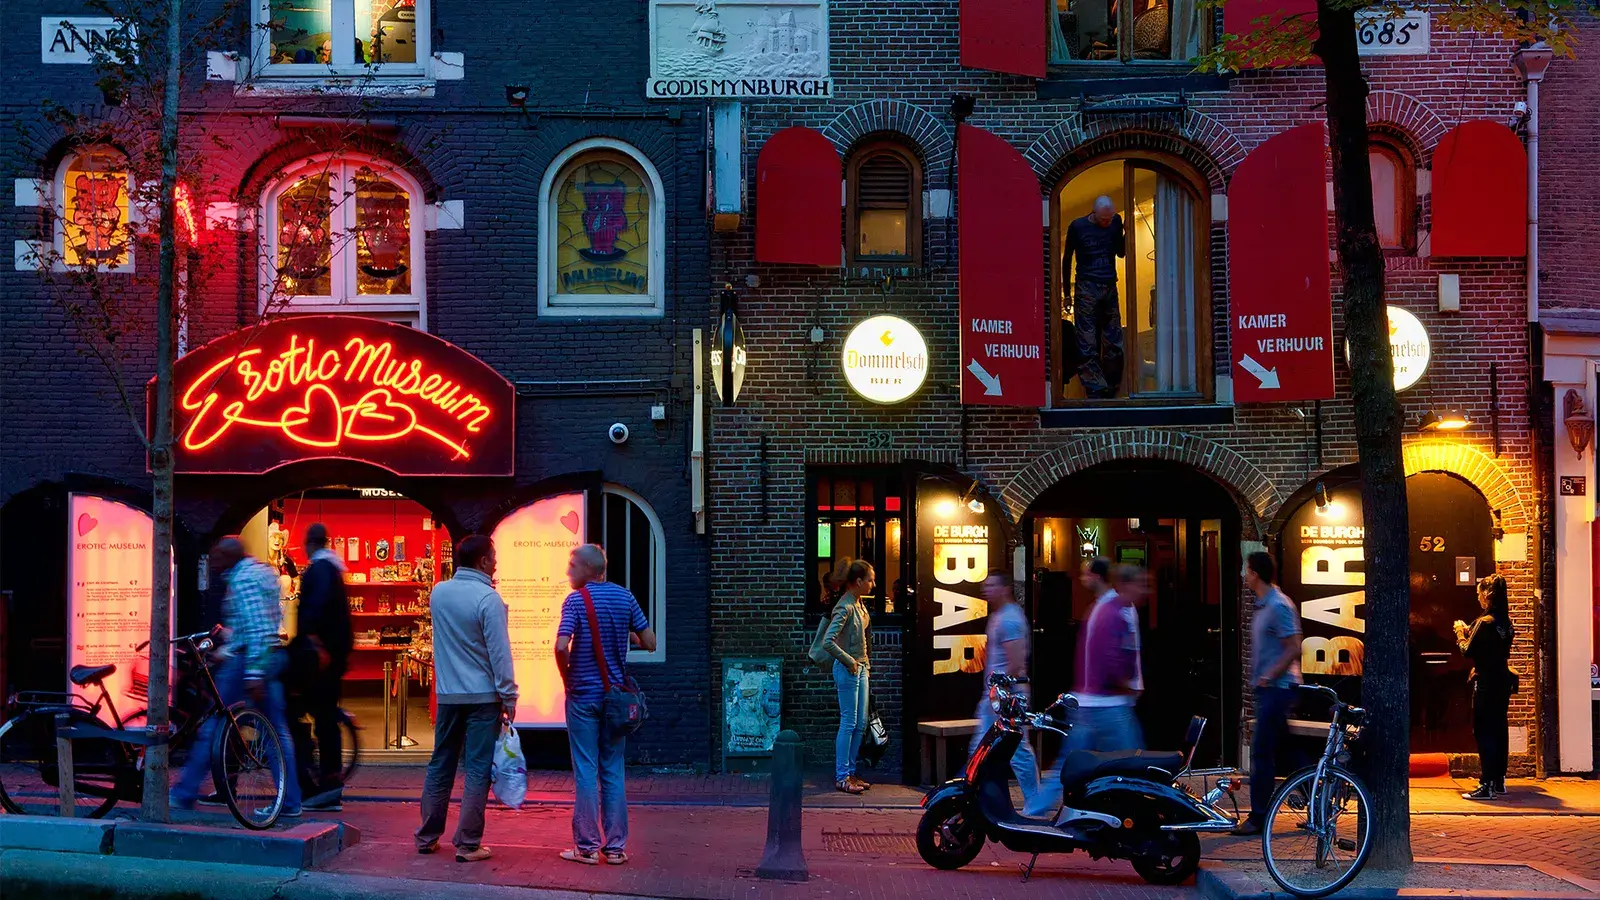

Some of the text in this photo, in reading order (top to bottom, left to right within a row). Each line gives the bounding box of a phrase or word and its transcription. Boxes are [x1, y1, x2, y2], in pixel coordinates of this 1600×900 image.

[49, 28, 129, 53] ANN
[1359, 22, 1419, 45] 685
[972, 318, 1013, 334] KAMER
[1239, 313, 1287, 329] KAMER
[984, 343, 1040, 359] VERHUUR
[1257, 337, 1324, 353] VERHUUR
[847, 349, 925, 371] Dommelsch
[182, 335, 490, 450] Erotic Museum
[868, 432, 891, 449] 52
[934, 526, 988, 538] DE BURGH
[1301, 526, 1365, 539] DE BURGH
[1420, 536, 1445, 552] 52
[934, 544, 988, 675] BAR
[1301, 545, 1365, 676] BAR
